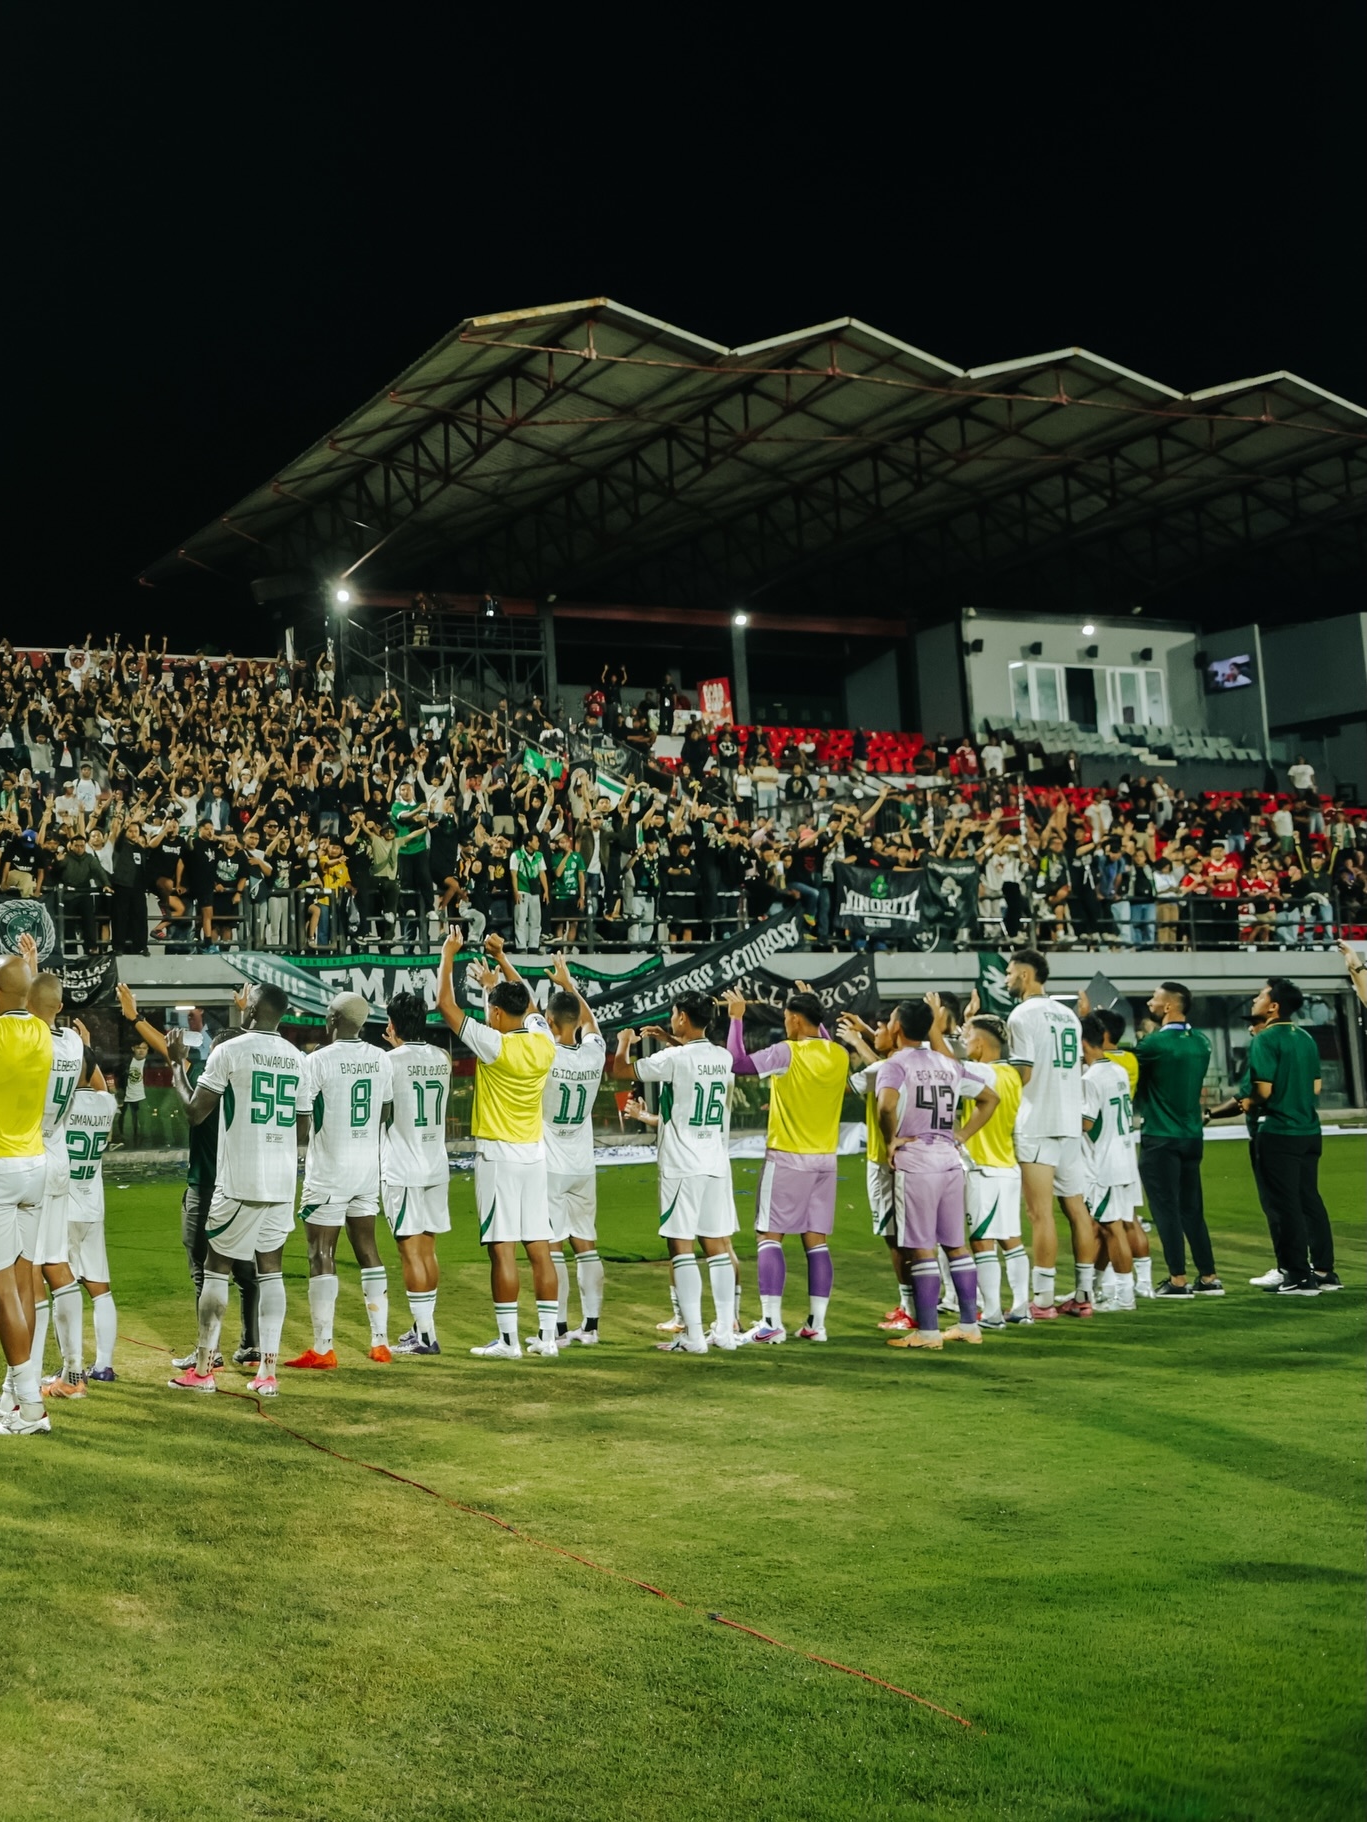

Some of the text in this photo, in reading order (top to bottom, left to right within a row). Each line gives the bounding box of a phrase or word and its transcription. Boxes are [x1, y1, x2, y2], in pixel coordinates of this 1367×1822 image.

[697, 1064, 727, 1076] SALMAN
[1051, 1025, 1078, 1069] 18
[52, 1076, 75, 1125] 4
[251, 1070, 300, 1127] 55
[350, 1078, 372, 1127] 8
[412, 1080, 444, 1127] 17
[553, 1082, 587, 1125] 11
[688, 1081, 726, 1127] 16
[915, 1085, 955, 1130] 43
